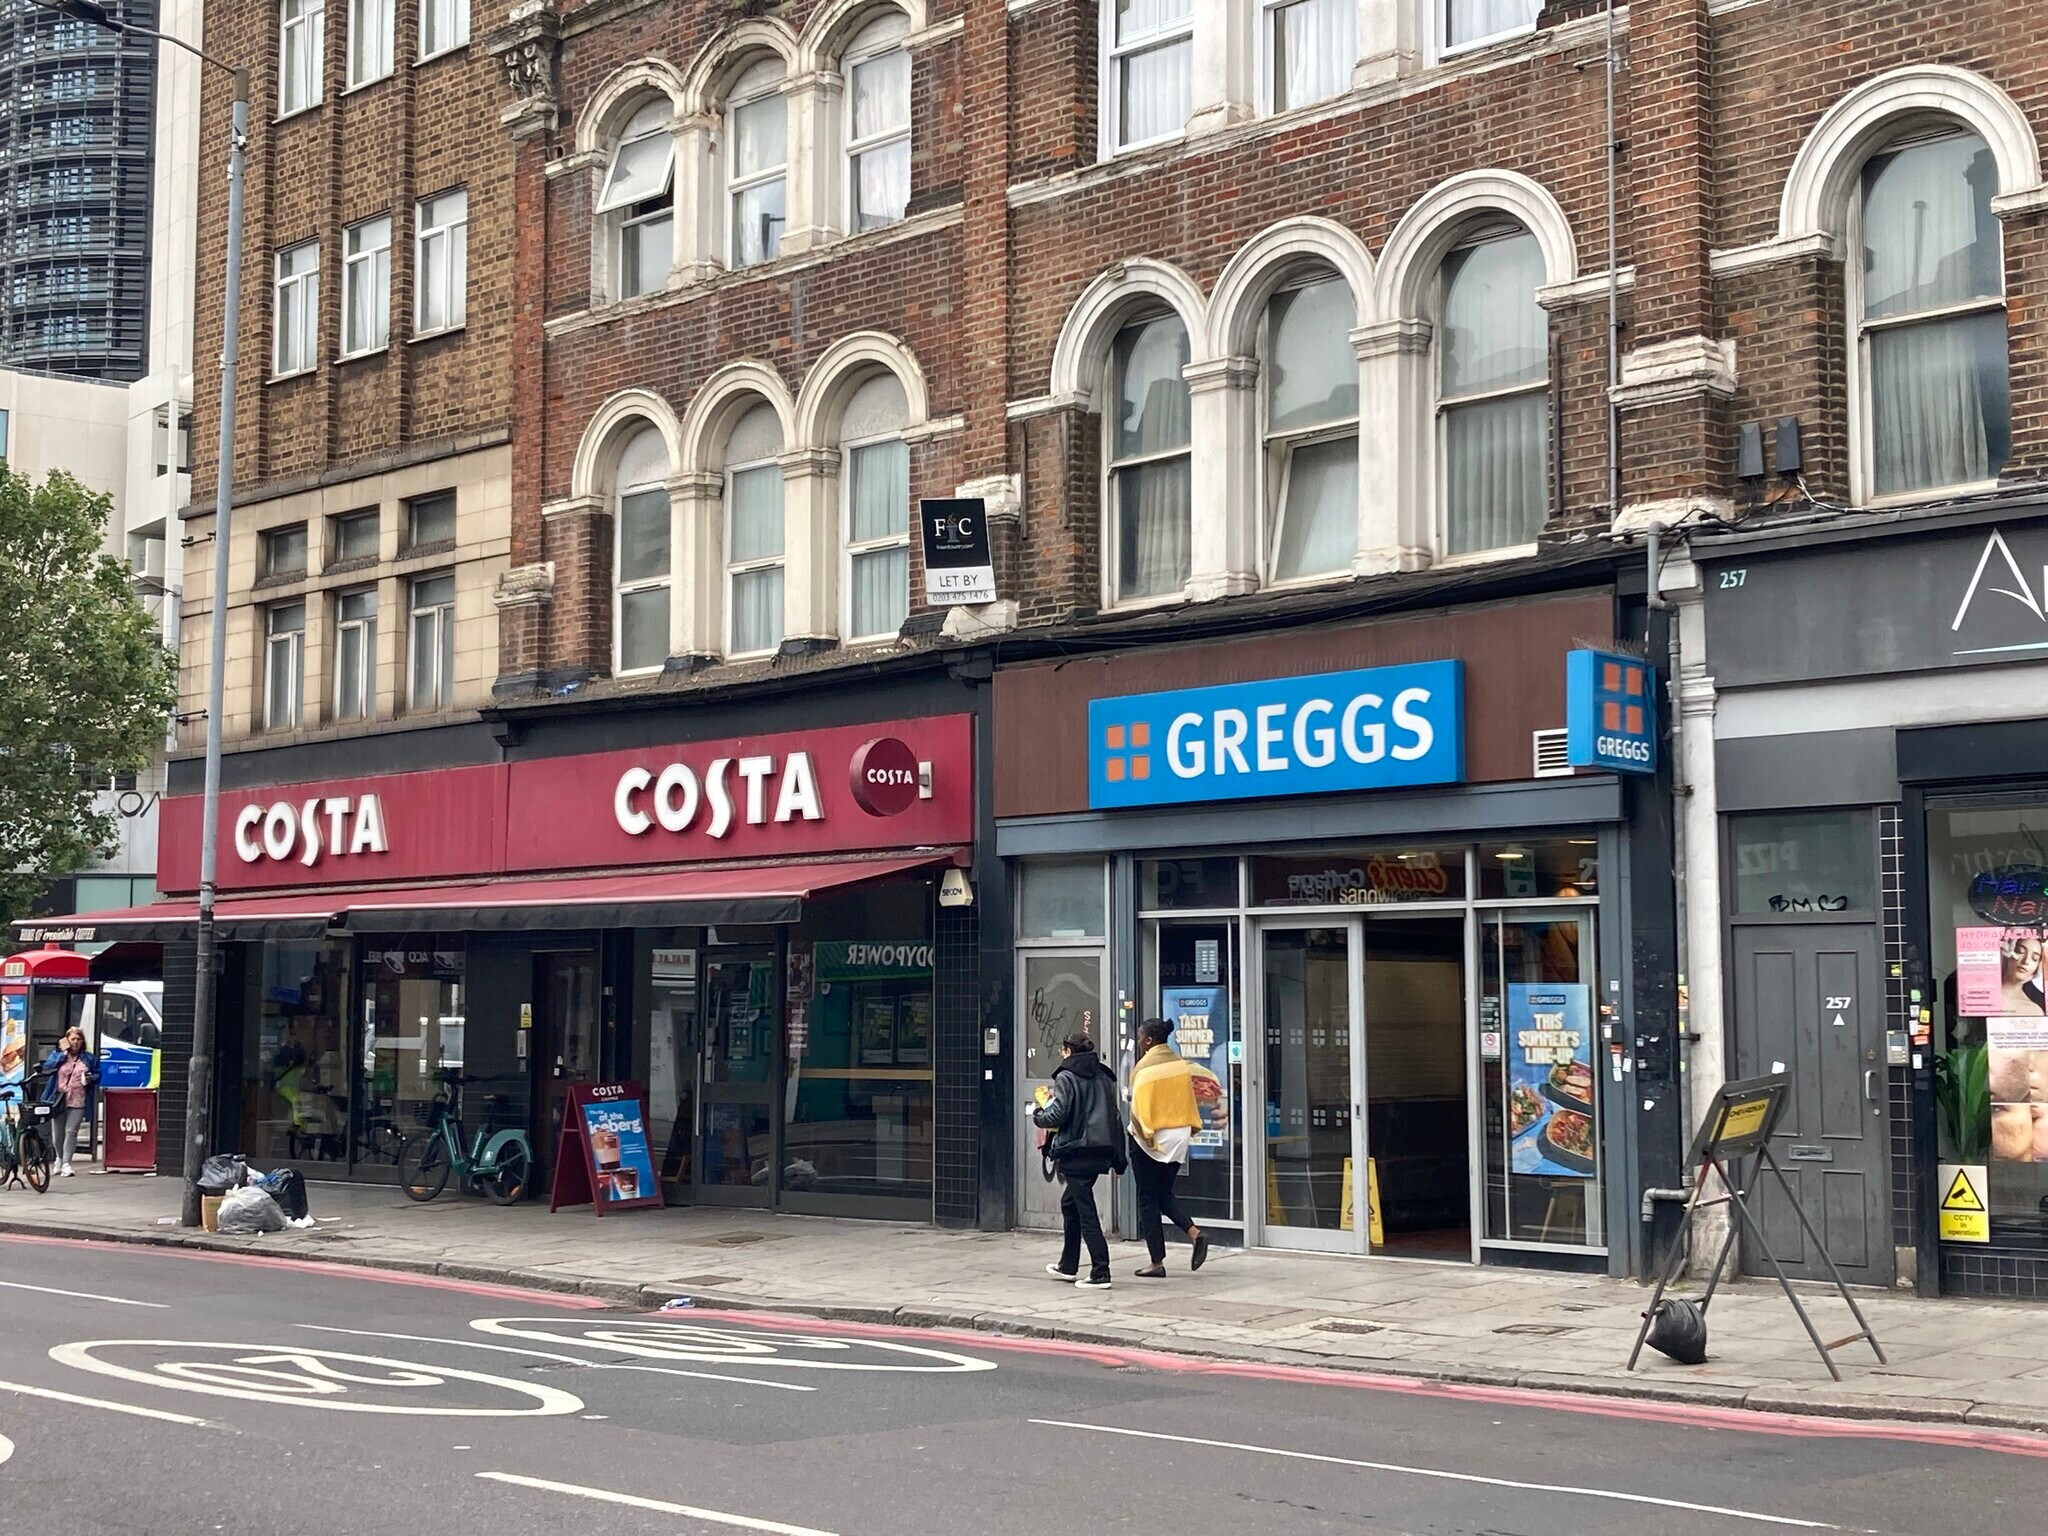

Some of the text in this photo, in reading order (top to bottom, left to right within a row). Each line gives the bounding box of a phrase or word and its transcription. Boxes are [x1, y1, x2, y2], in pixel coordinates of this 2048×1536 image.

[939, 574, 978, 588] LET BY
[1720, 569, 1748, 589] 257
[1952, 527, 2048, 631] A
[933, 592, 950, 602] 0203
[1166, 687, 1434, 779] GREGGS
[1597, 735, 1650, 762] GREGGS
[867, 768, 914, 785] COSTA
[614, 752, 825, 839] COSTA
[235, 794, 388, 867] COSTA
[1826, 996, 1851, 1009] 257
[1178, 1014, 1210, 1030] TASTY
[1533, 1013, 1563, 1031] THIS
[1175, 1029, 1214, 1044] SUMMER
[1518, 1030, 1580, 1048] SUMMER'S
[1179, 1043, 1211, 1059] VALUE
[1525, 1047, 1574, 1064] LINE-UP
[592, 1085, 624, 1096] COSTA
[609, 1112, 624, 1121] the
[120, 1117, 148, 1134] COSTA
[588, 1118, 642, 1135] iceberg
